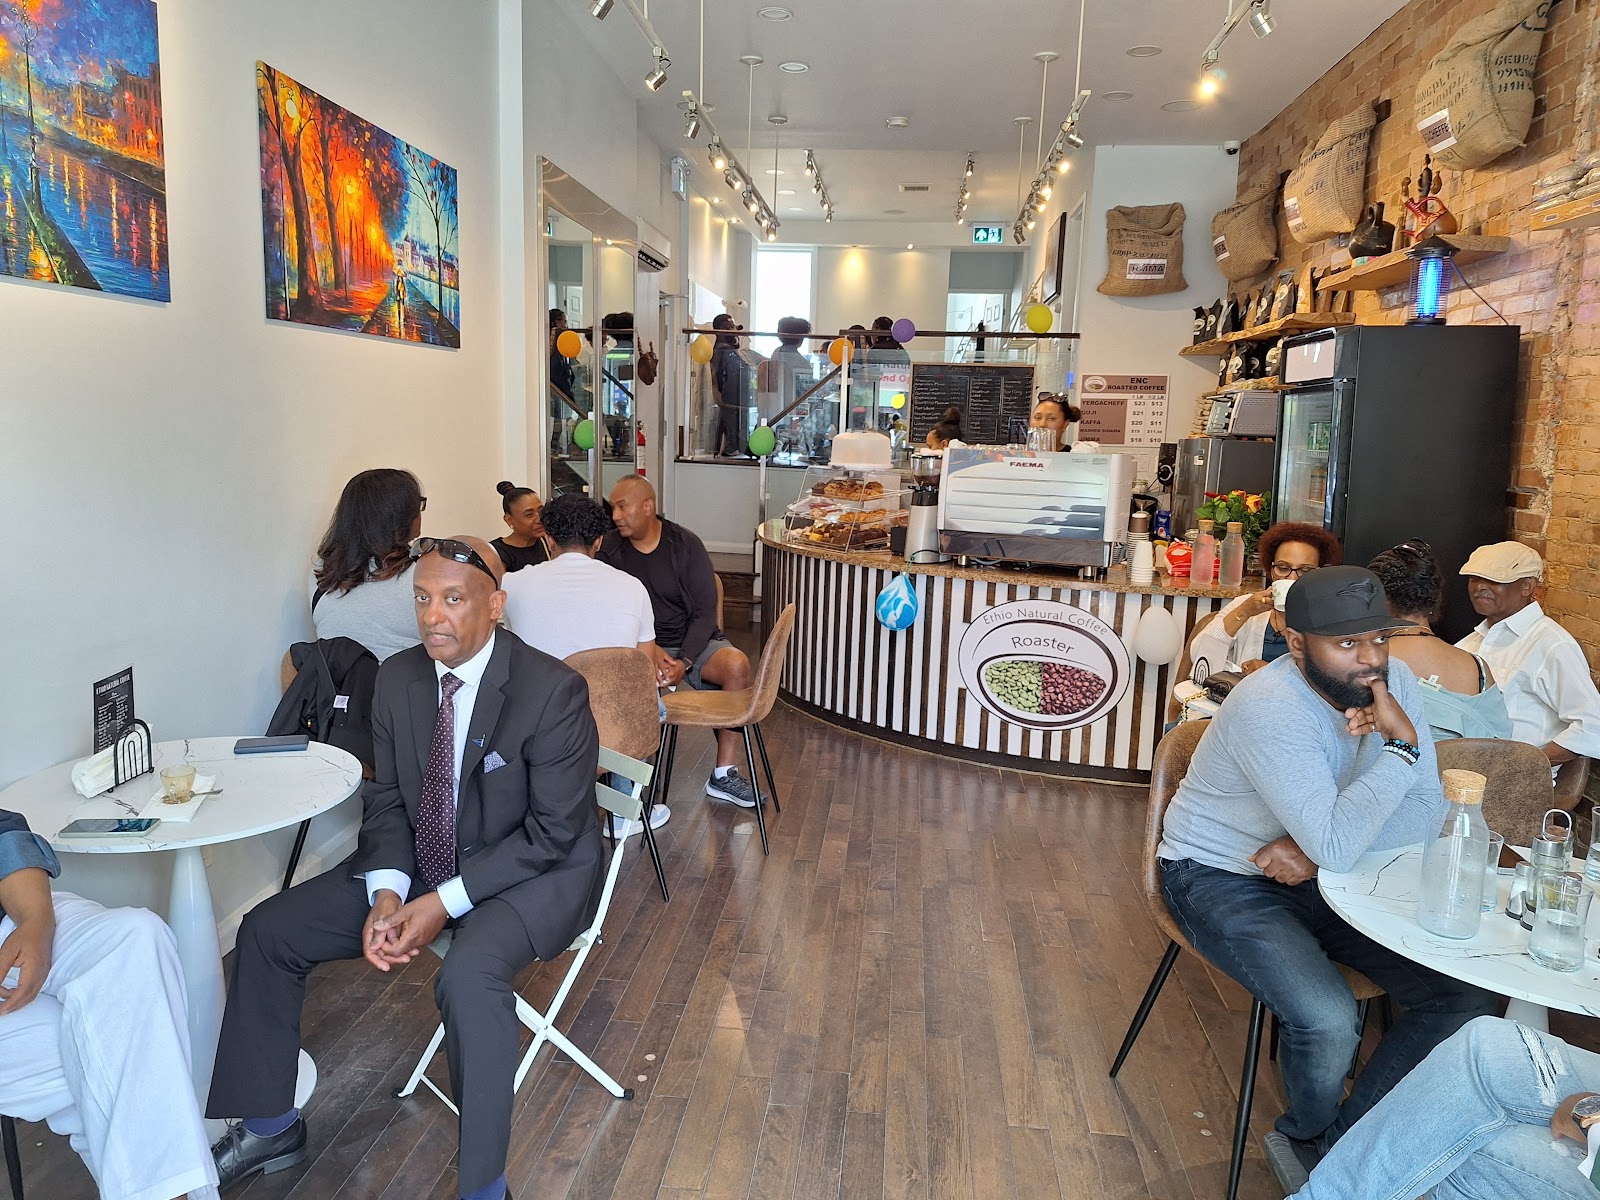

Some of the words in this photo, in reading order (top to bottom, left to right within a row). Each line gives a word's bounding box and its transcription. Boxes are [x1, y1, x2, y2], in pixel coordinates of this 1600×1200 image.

[982, 610, 1012, 625] Ethio
[1017, 608, 1062, 620] Natural
[1068, 614, 1108, 635] Coffee
[1011, 636, 1074, 654] Roaster
